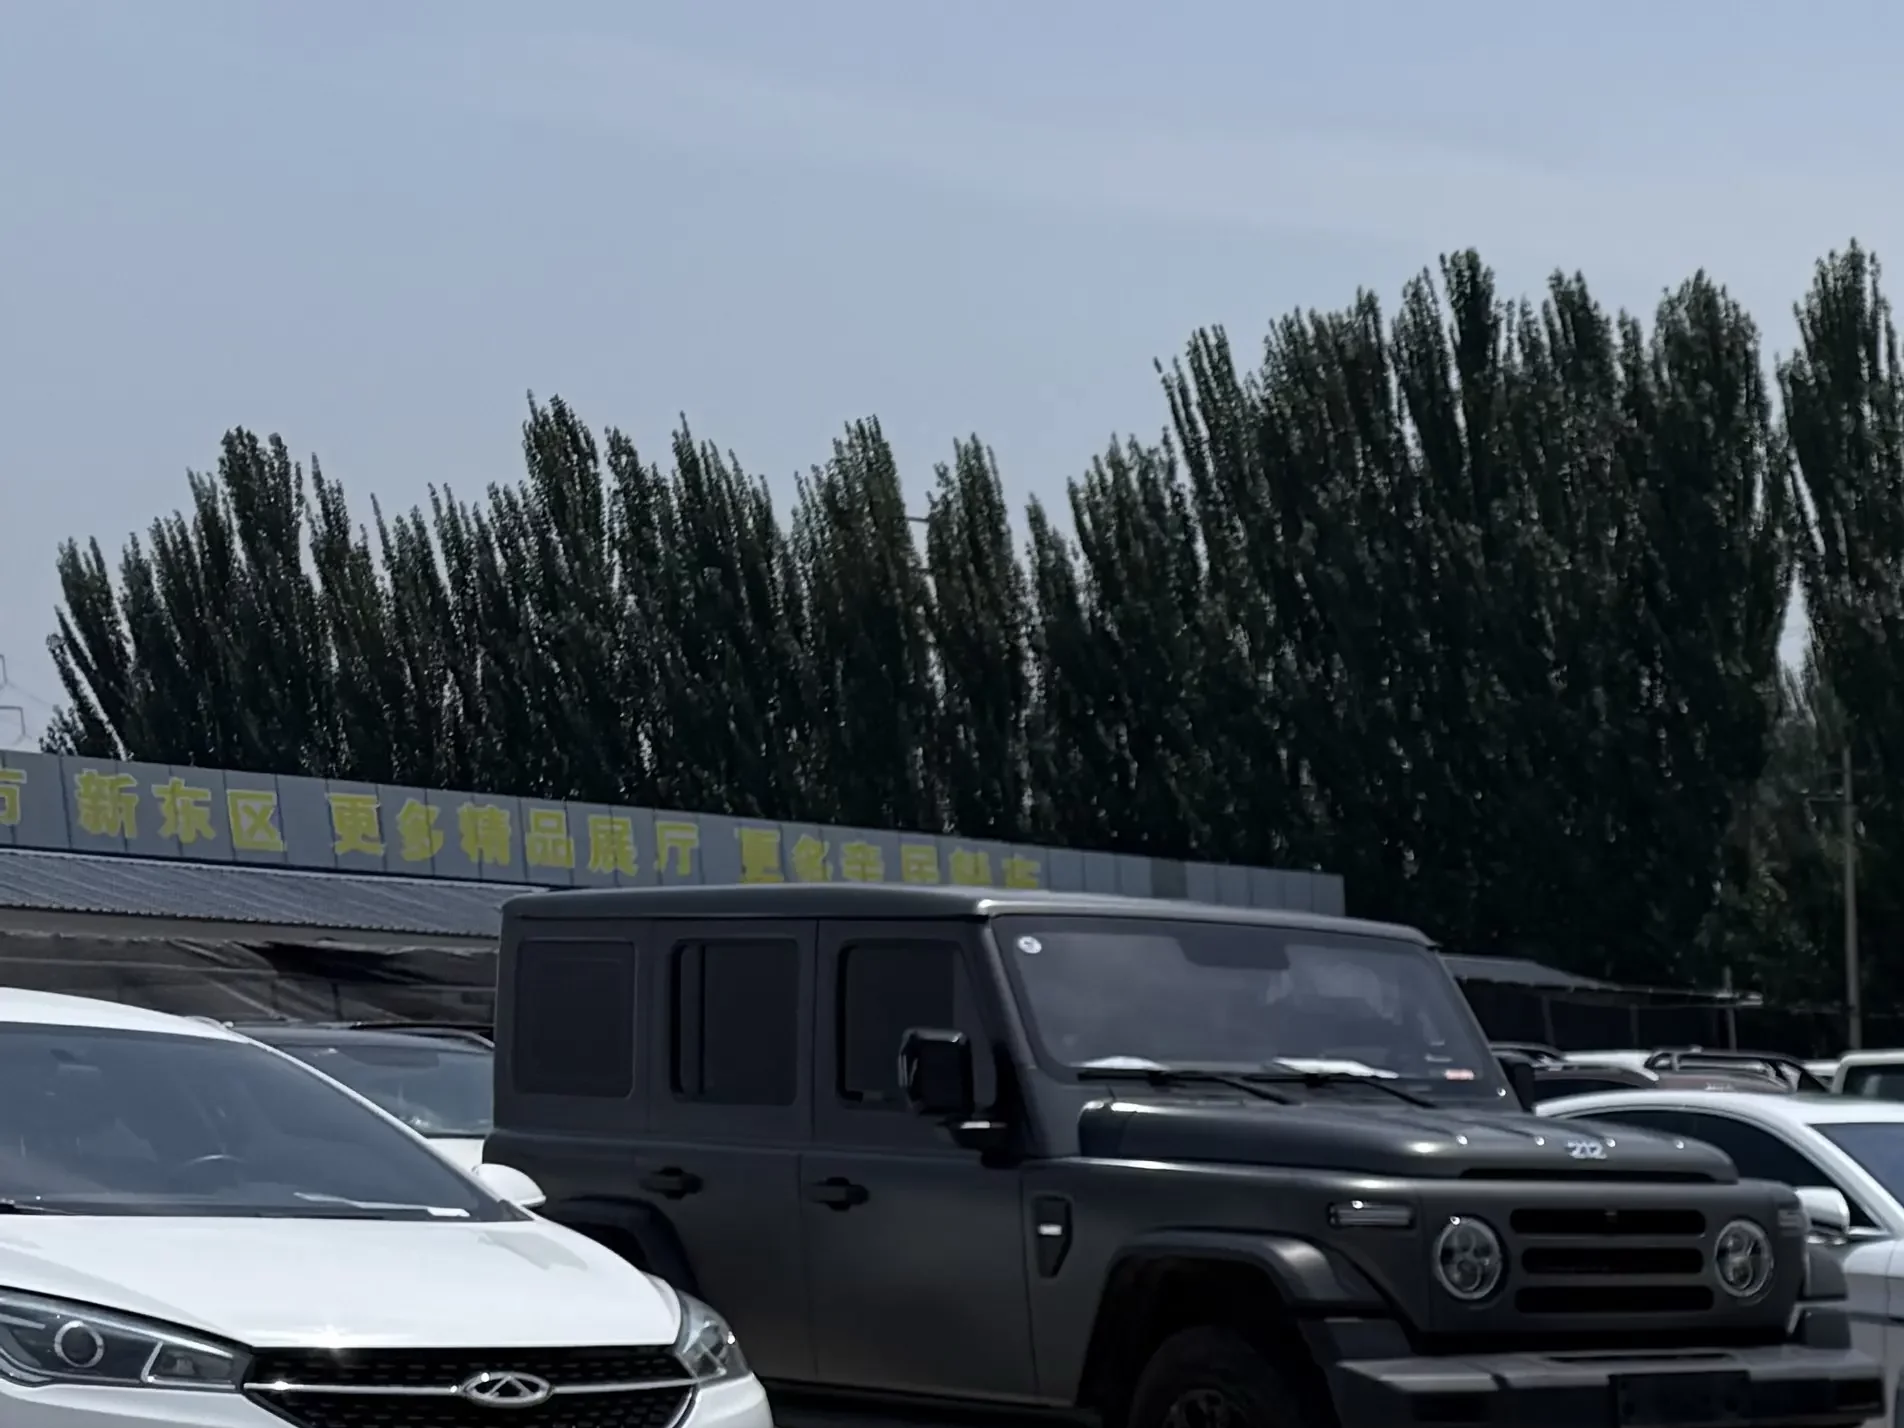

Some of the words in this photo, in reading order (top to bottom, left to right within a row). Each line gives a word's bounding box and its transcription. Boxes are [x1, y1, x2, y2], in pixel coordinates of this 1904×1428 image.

[76, 768, 286, 851] 新东区
[325, 792, 700, 877] 更多精品展厅
